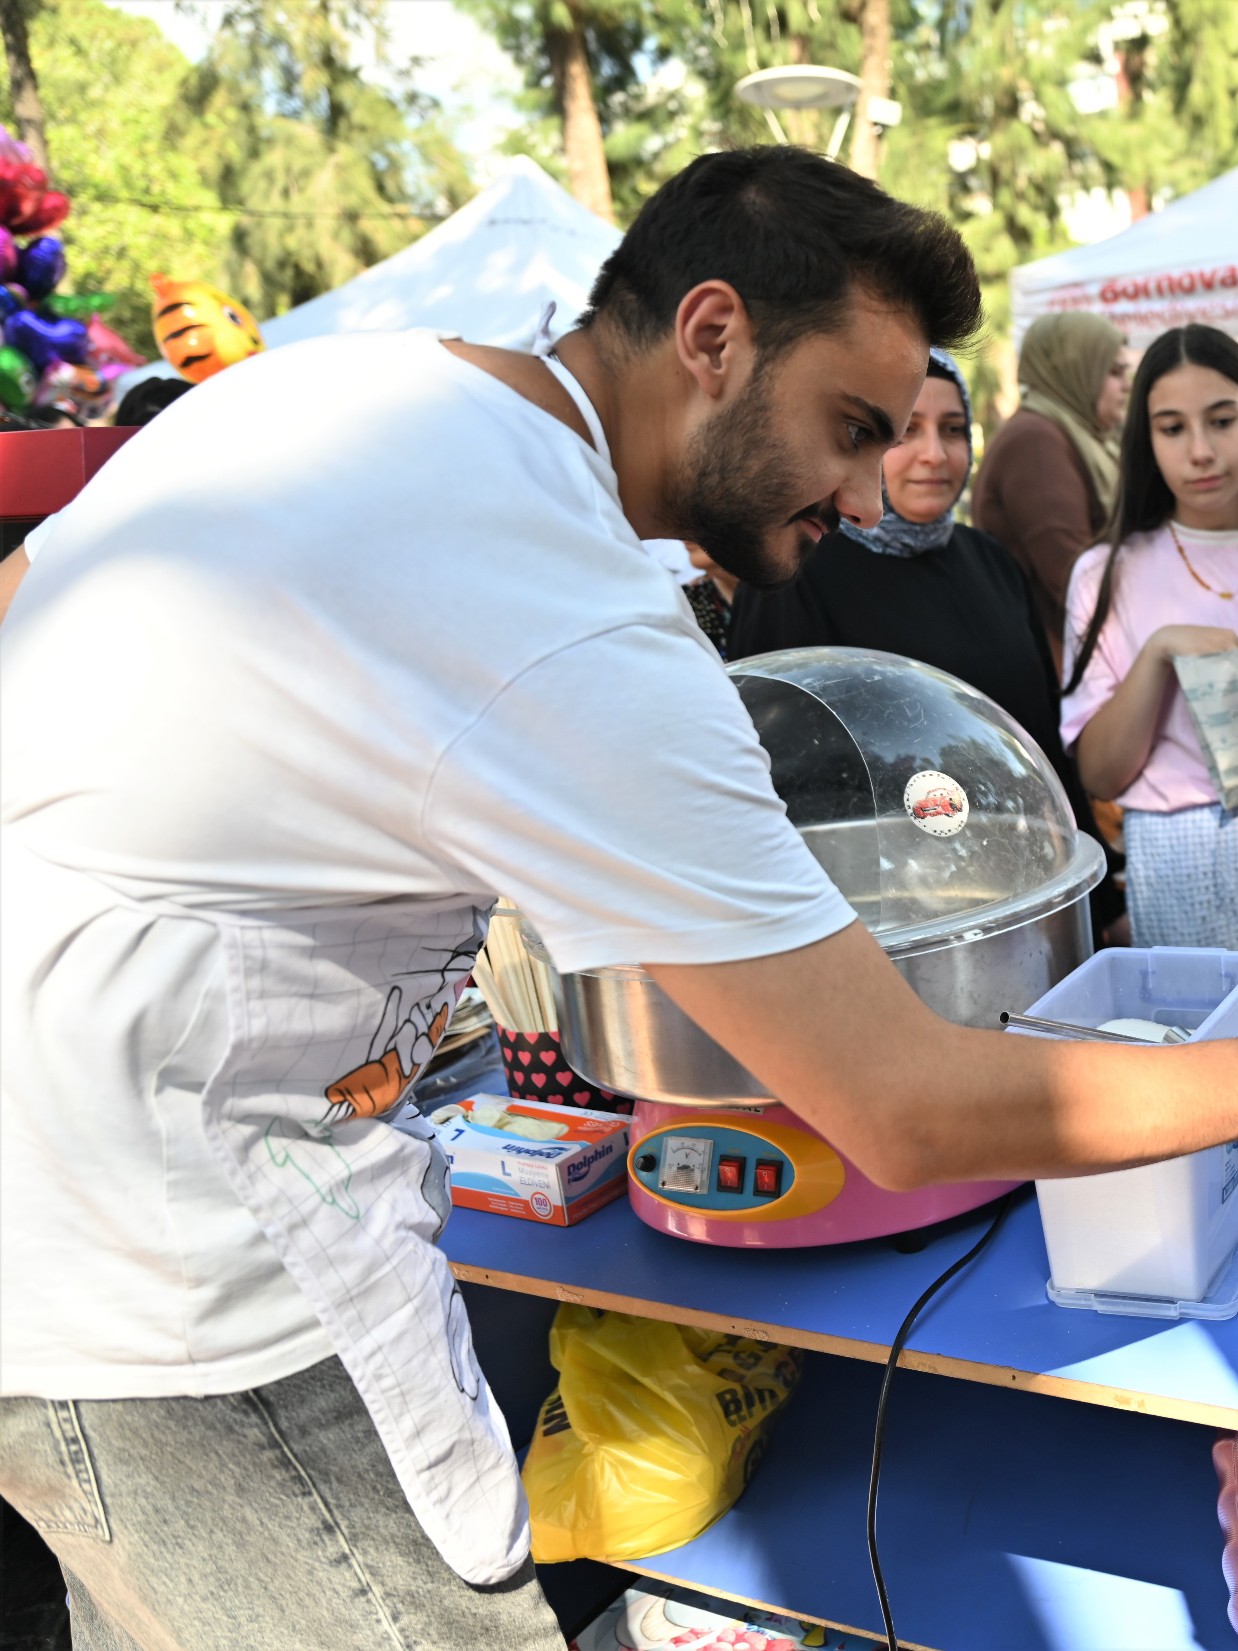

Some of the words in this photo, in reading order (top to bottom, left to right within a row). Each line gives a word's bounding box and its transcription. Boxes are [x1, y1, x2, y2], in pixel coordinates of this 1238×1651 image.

[501, 1143, 564, 1159] Dolphin
[501, 1160, 512, 1177] L
[567, 1144, 613, 1178] Dolphin
[534, 1197, 548, 1207] 100
